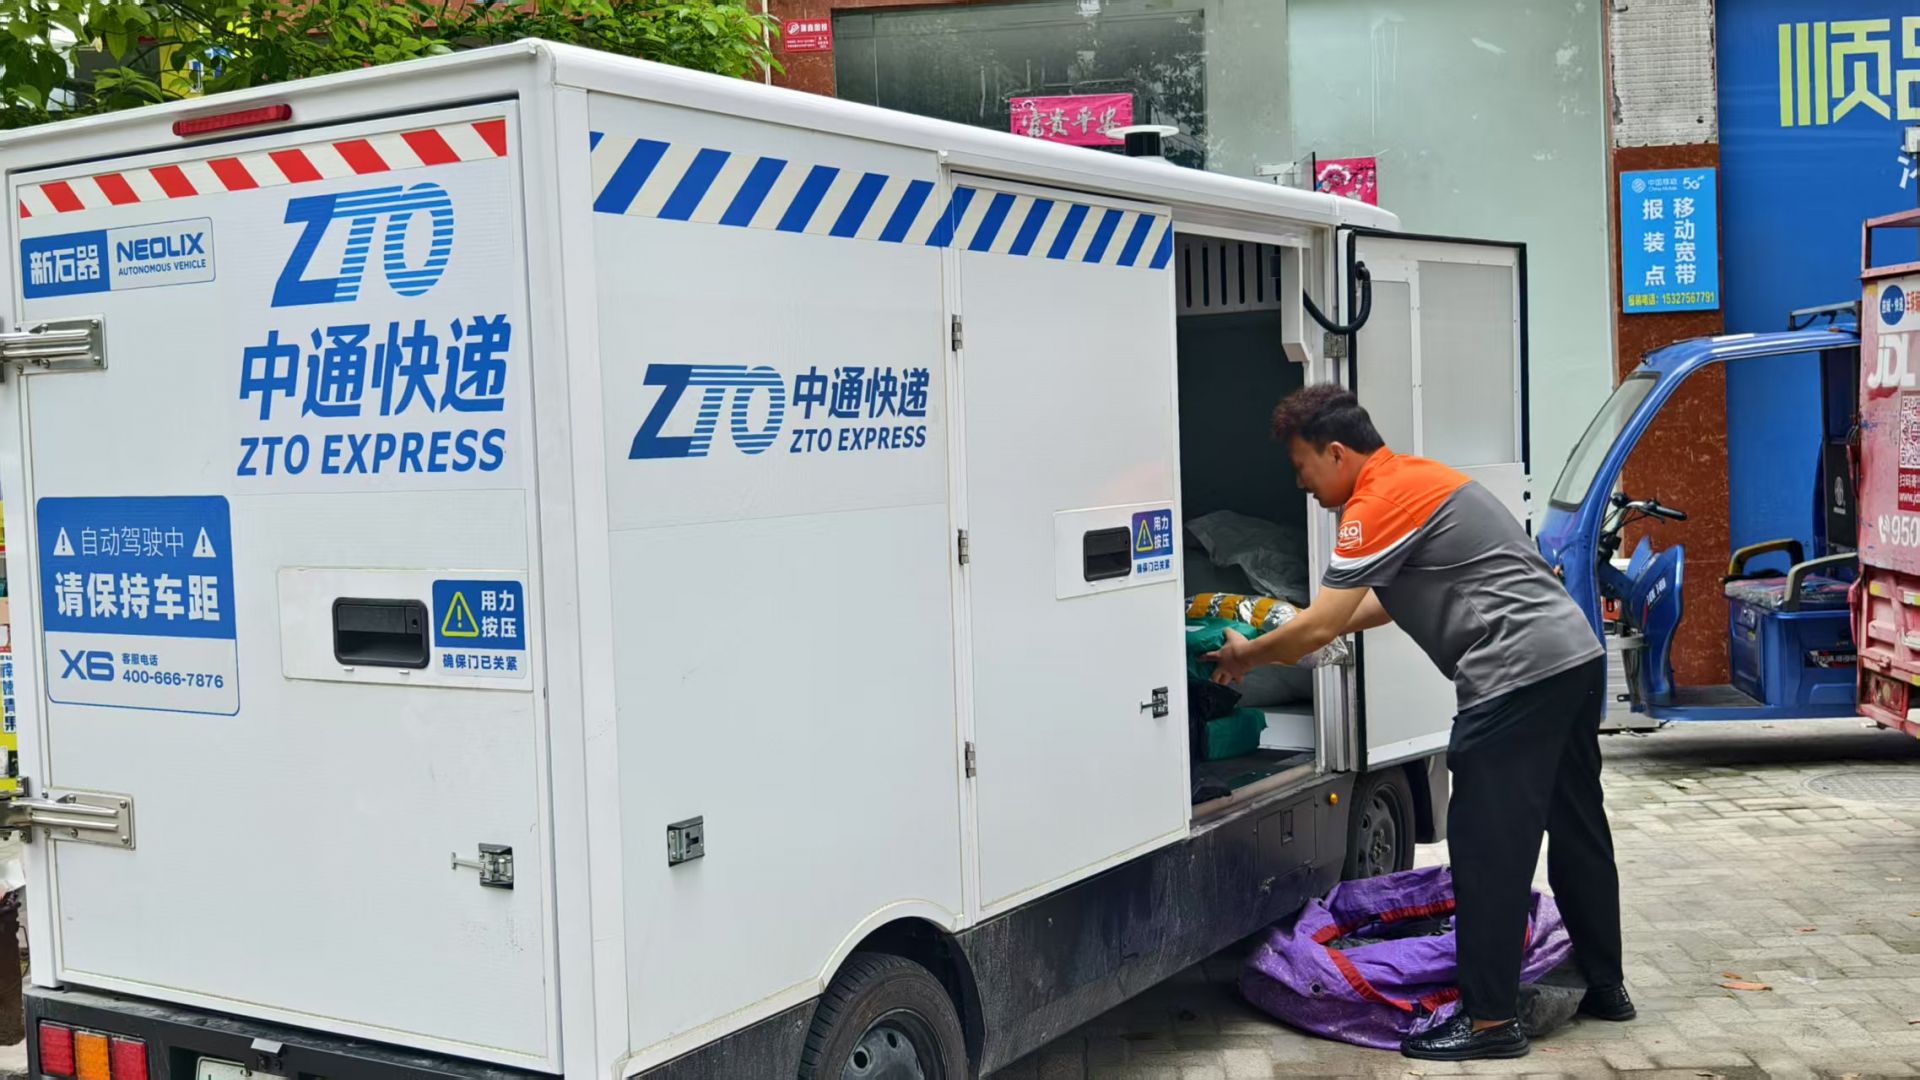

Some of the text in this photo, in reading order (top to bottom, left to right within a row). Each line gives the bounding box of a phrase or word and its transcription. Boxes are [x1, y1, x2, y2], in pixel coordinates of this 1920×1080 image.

[116, 232, 205, 264] NEOLIX
[271, 182, 454, 308] ZTO
[1642, 199, 1666, 287] 报装点
[1673, 197, 1696, 285] 移动宽带
[30, 242, 101, 286] 新石器
[118, 258, 206, 277] AUTONOMOUS VEHICLE
[239, 313, 512, 421] 中通快递
[792, 366, 930, 420] 中通快递
[629, 363, 786, 460] ZTO
[236, 428, 507, 477] ZTO EXPRESS
[789, 425, 926, 454] ZTO EXPRESS
[1153, 516, 1169, 530] 用力
[81, 526, 184, 557] 自动驾驶中
[1153, 533, 1170, 549] 按压
[54, 571, 220, 621] 请保持车距
[481, 590, 515, 611] 用力
[481, 616, 517, 638] 按压
[59, 649, 115, 682] X6
[121, 652, 158, 667] 客服电话
[442, 654, 518, 672] 确保门已关紧
[122, 669, 224, 689] 400-666-7876
